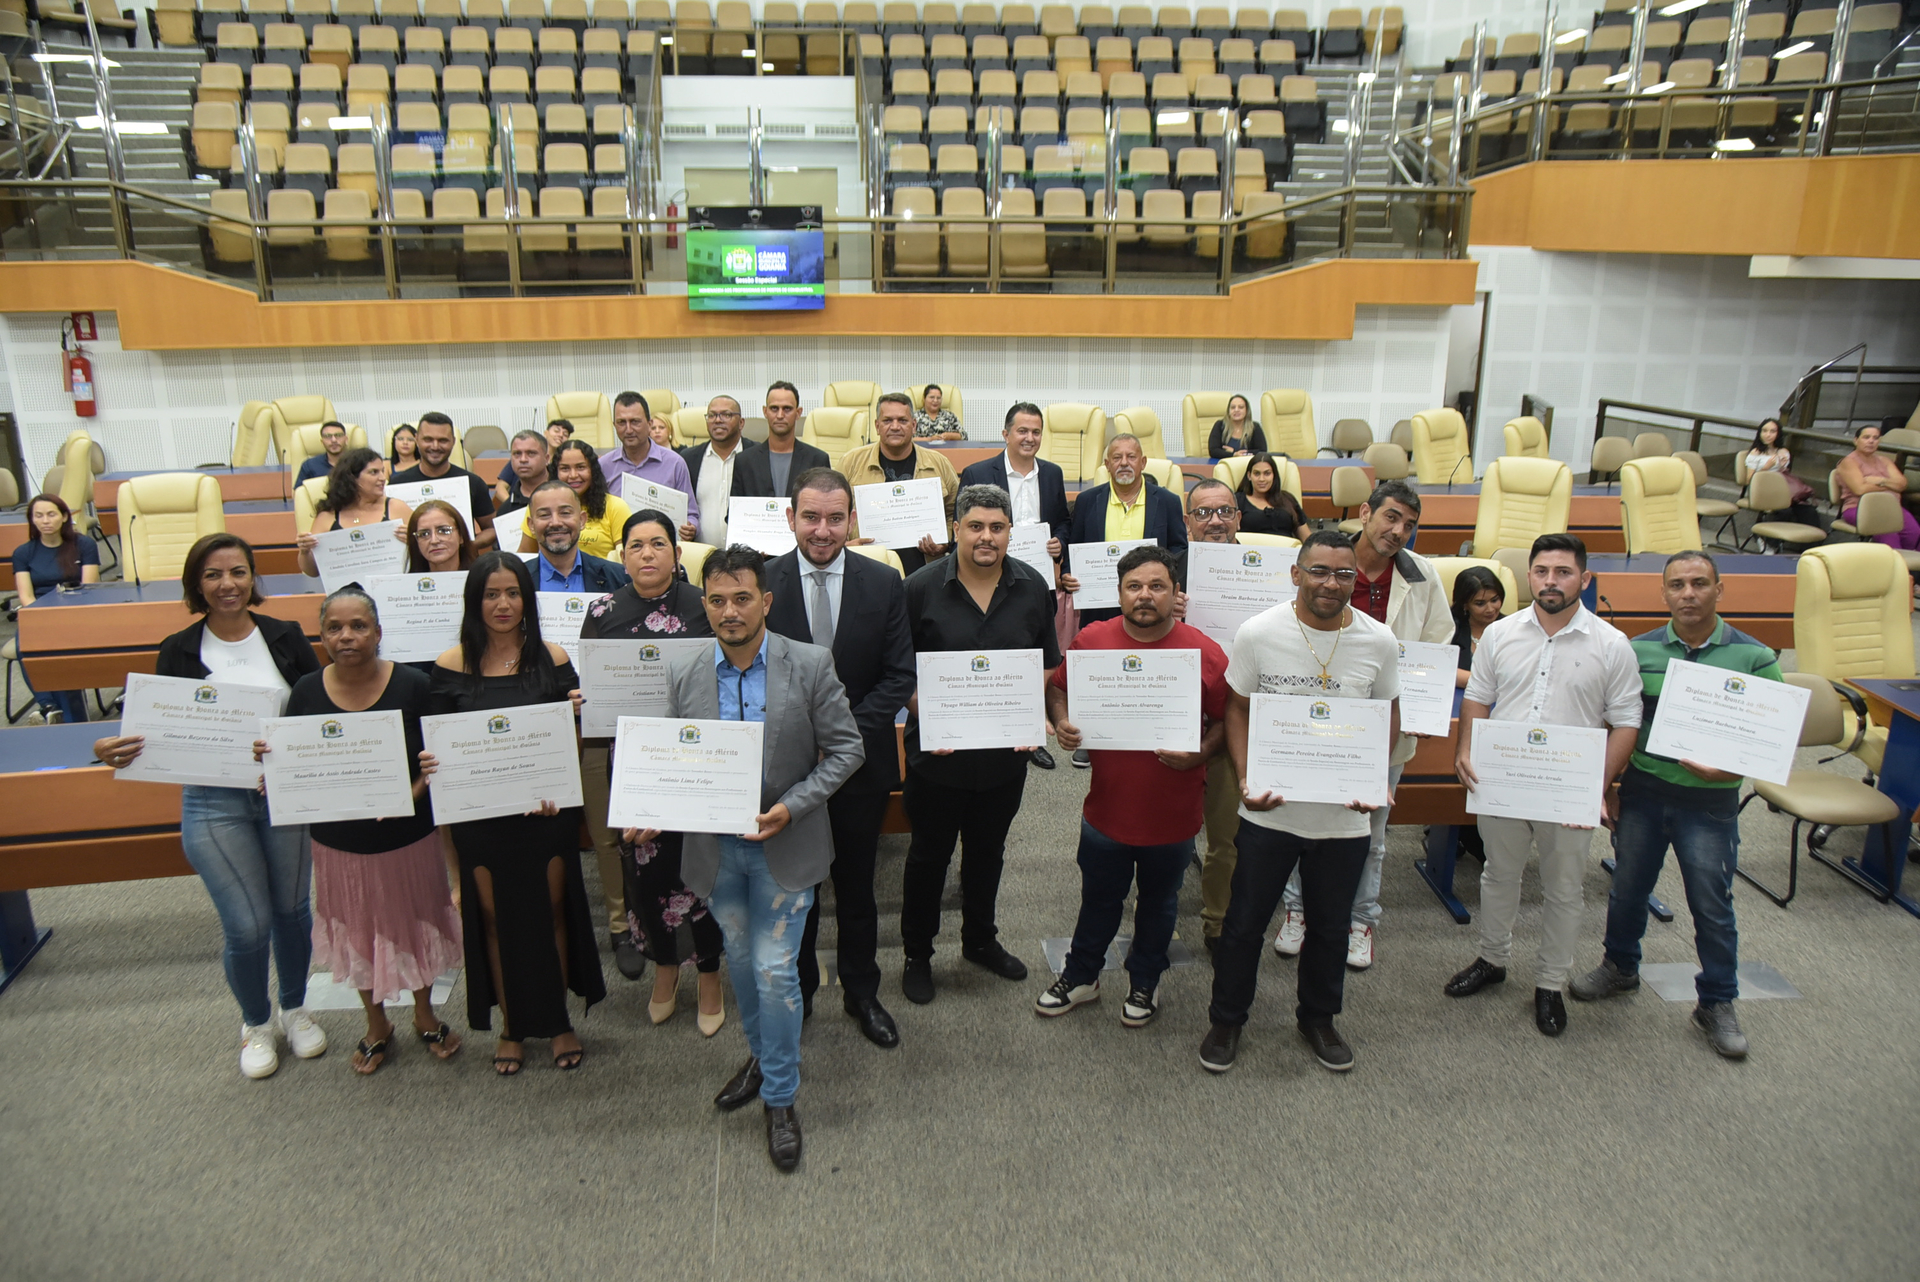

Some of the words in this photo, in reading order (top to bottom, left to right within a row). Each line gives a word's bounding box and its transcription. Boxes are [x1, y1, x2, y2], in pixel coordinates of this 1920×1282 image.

[758, 251, 786, 259] CÂMARA
[758, 262, 787, 271] GOIÂNIA
[1208, 567, 1234, 575] Diploma
[1685, 686, 1713, 698] Diploma
[1724, 694, 1745, 705] Honra
[152, 702, 184, 711] Diploma
[196, 705, 219, 714] Honra
[230, 708, 255, 717] Mérito
[1713, 700, 1738, 712] Municipal
[185, 713, 213, 722] Municipal
[1272, 720, 1300, 728] Diploma
[1692, 715, 1714, 725] Luzimar
[1715, 719, 1737, 730] Barbosa
[1738, 724, 1756, 735] Moura
[163, 732, 188, 740] Gilmara
[188, 734, 211, 742] Bezerra
[451, 740, 482, 749] Diploma
[528, 731, 552, 740] Mérito
[327, 741, 348, 749] Honra
[360, 738, 382, 746] Mérito
[462, 748, 484, 756] Câmara
[485, 746, 511, 754] Municipal
[641, 745, 670, 754] Diploma
[714, 748, 739, 756] Mérito
[1493, 744, 1519, 752] Diploma
[1530, 747, 1549, 755] Honra
[1316, 751, 1346, 759] Evangelista
[470, 767, 491, 776] Débora
